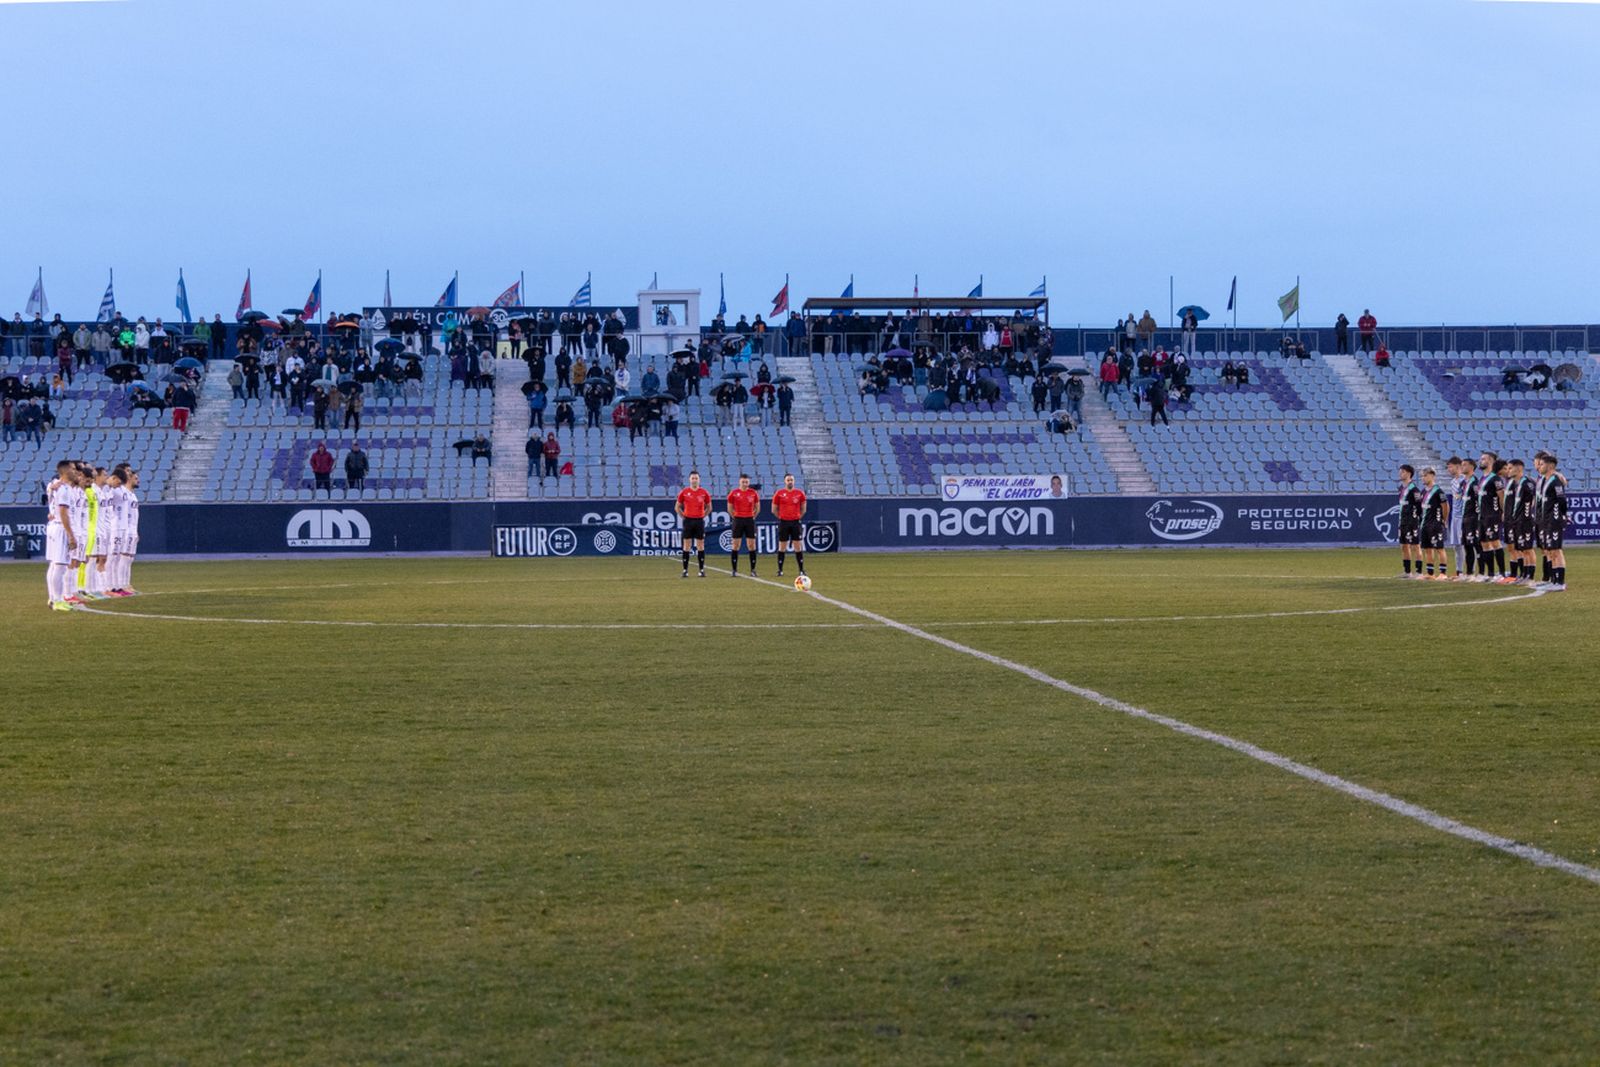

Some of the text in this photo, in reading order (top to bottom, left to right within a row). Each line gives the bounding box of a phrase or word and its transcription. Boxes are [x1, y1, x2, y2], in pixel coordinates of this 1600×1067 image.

[987, 478, 1009, 487] REAL
[1238, 507, 1366, 518] PROTECCION Y
[898, 506, 1054, 536] macron
[1164, 515, 1222, 533] proseja
[1251, 520, 1353, 530] SEGURIDAD
